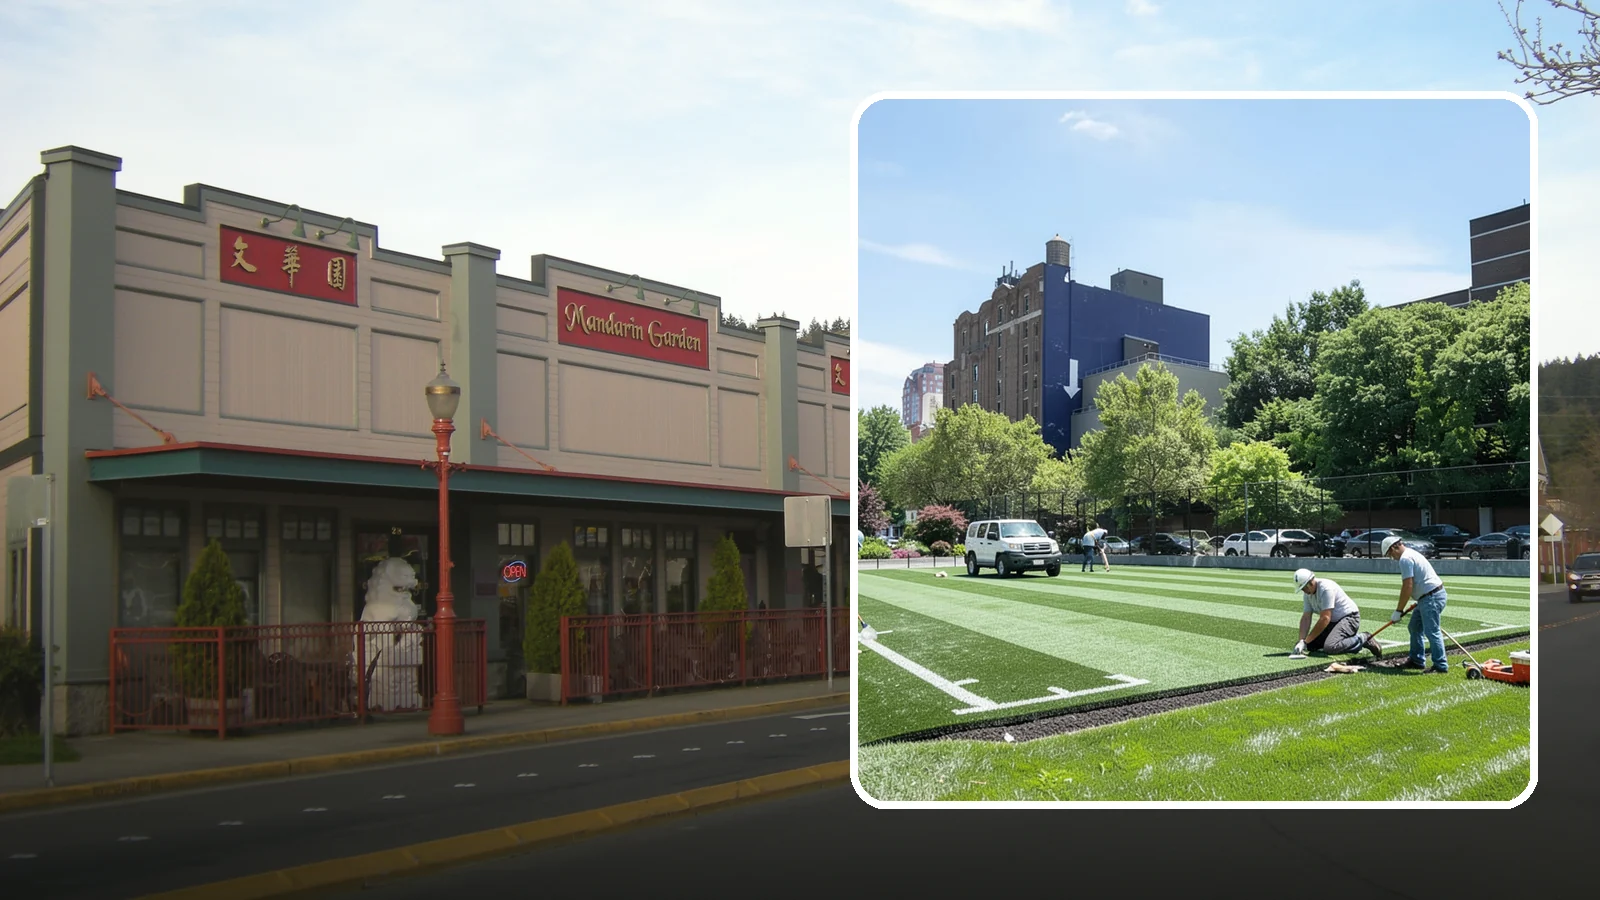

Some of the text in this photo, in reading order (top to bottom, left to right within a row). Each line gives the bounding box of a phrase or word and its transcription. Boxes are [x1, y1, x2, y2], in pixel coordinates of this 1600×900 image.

[230, 235, 346, 291] 文華園
[564, 302, 701, 352] Mandarin Garden
[503, 565, 527, 578] OPEN
